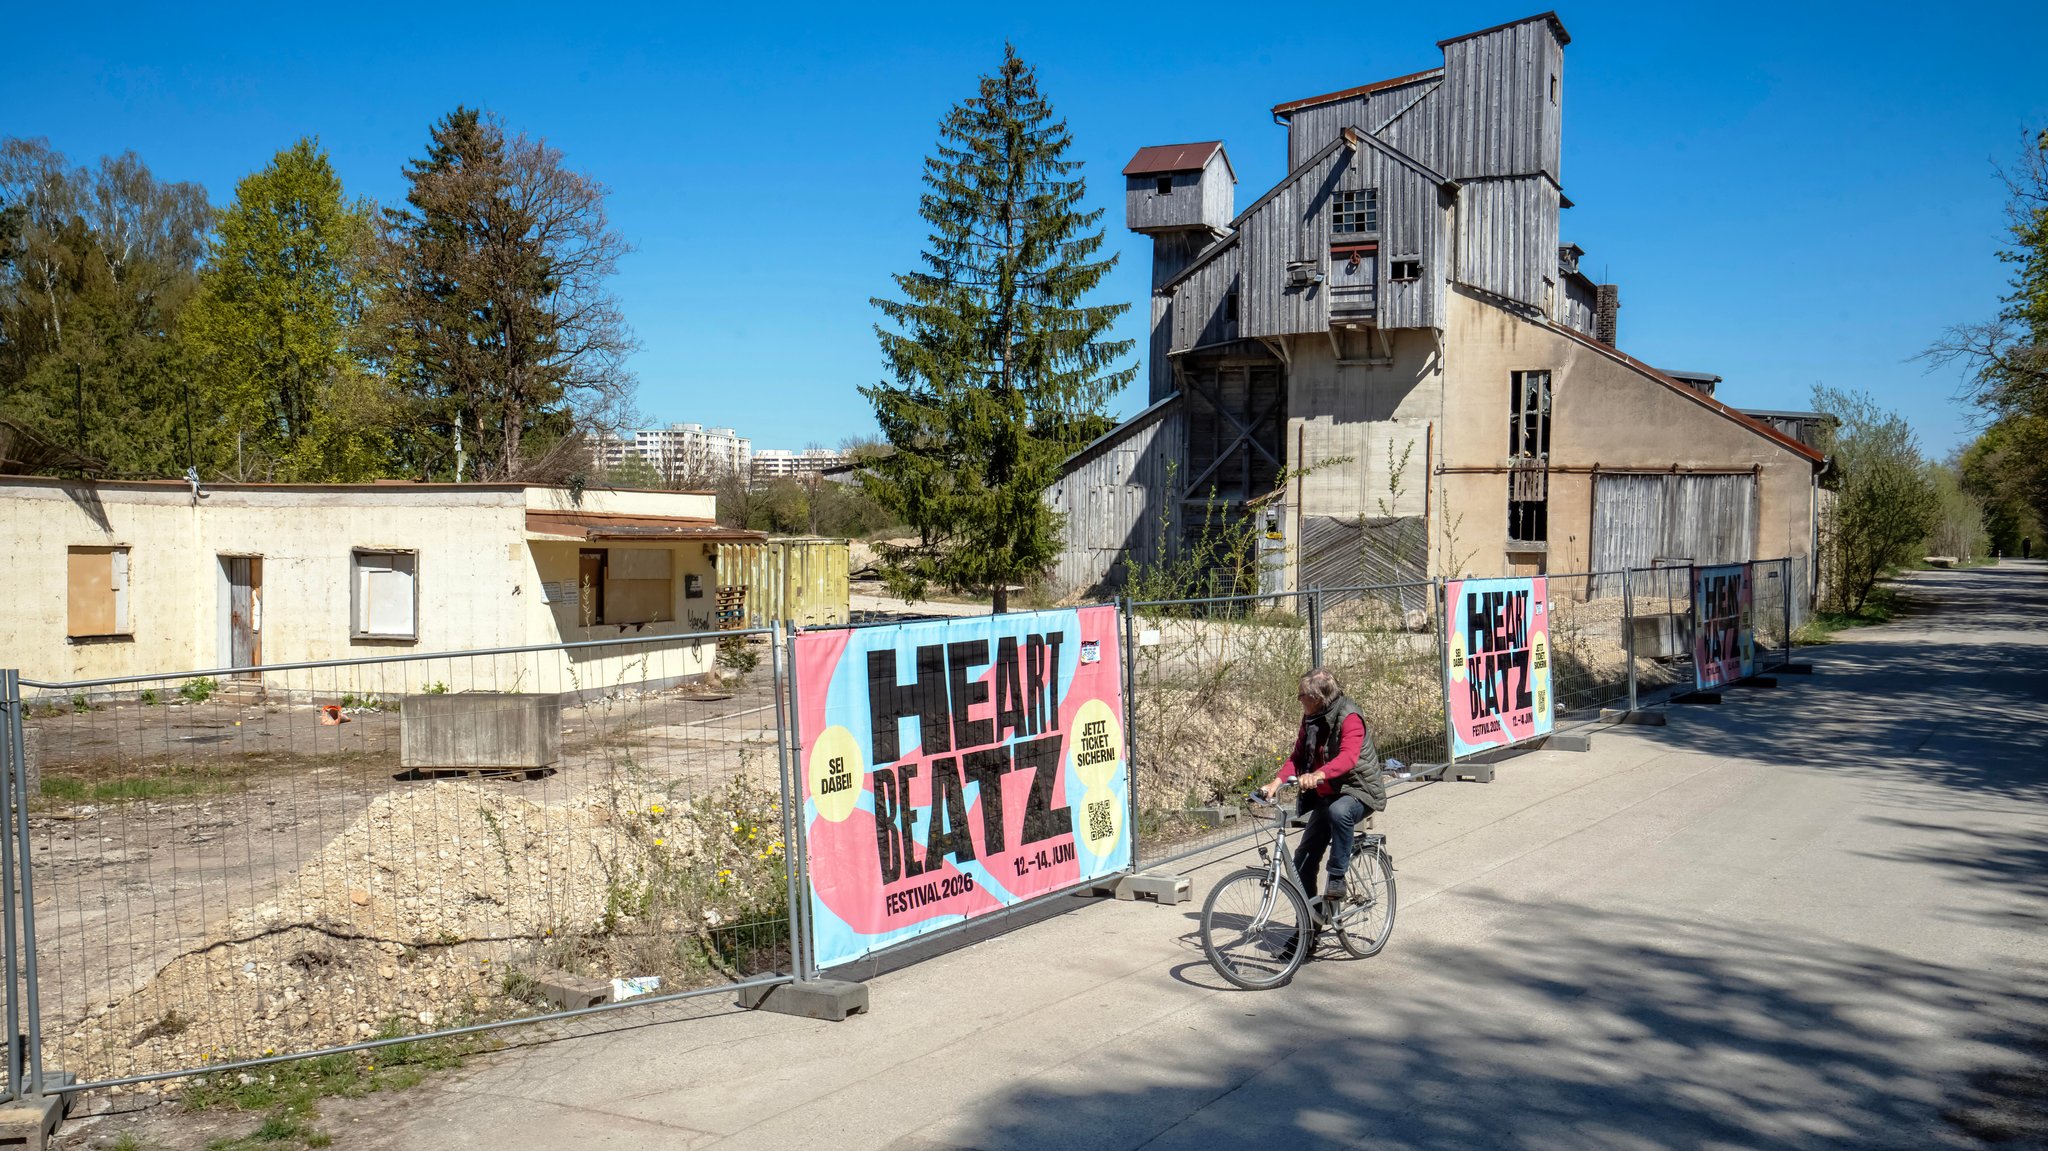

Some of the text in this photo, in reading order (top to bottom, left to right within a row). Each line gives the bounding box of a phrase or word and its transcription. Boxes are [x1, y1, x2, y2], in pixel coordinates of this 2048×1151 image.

[1467, 590, 1529, 655] HEART
[1468, 649, 1533, 720] BEATZ
[866, 630, 1064, 765] HEART
[1082, 720, 1106, 737] JETZT
[1081, 734, 1109, 751] TICKET
[828, 756, 844, 775] SEI
[1077, 747, 1115, 767] SICHERN!
[821, 772, 852, 795] DABEI!
[872, 735, 1073, 886] BEATZ
[1052, 842, 1075, 865] JUNI
[886, 872, 974, 917] FESTIVAL 2026
